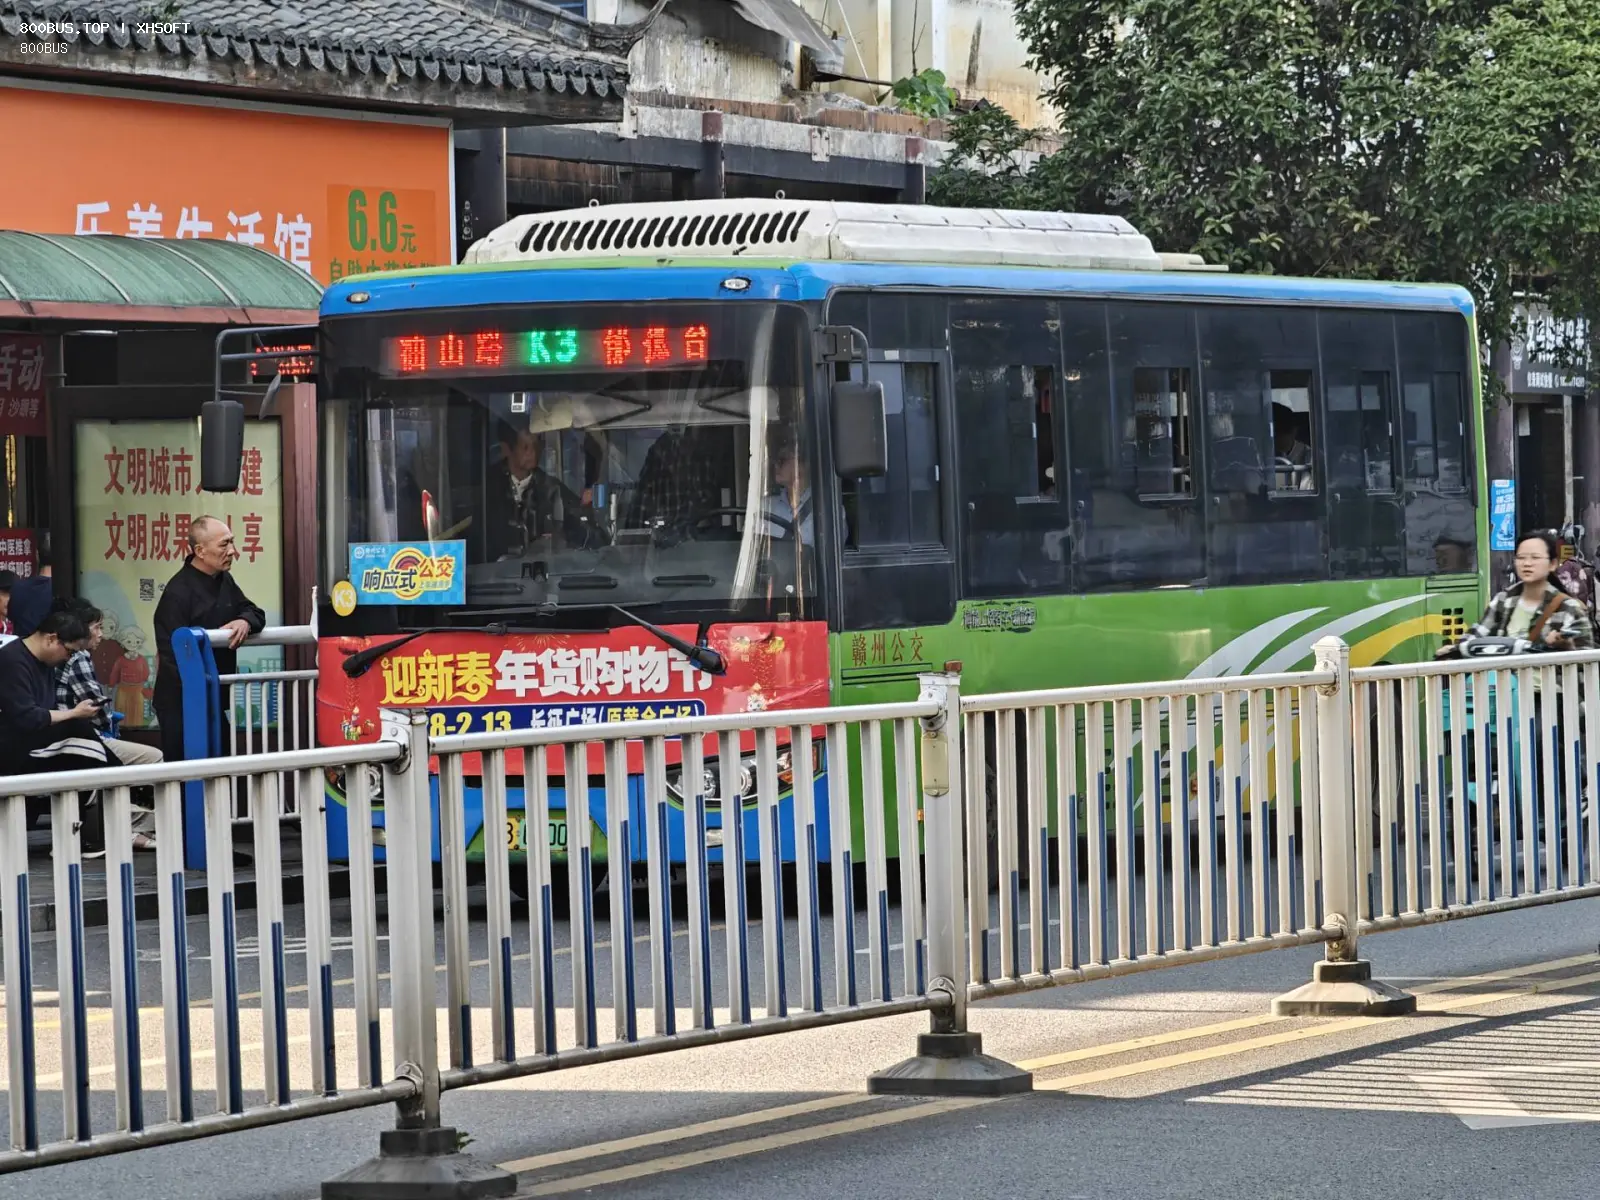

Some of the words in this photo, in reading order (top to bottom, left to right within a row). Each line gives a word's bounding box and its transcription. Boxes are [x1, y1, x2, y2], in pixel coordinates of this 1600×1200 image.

[347, 189, 417, 254] 6.6元
[529, 330, 577, 363] K3
[104, 446, 264, 496] 文明城市建
[104, 511, 264, 563] 文明成果享
[363, 568, 418, 591] 响应式
[419, 556, 454, 579] 公交
[333, 588, 354, 608] K3
[851, 632, 924, 667] 赣州公交
[429, 710, 512, 737] 8-213
